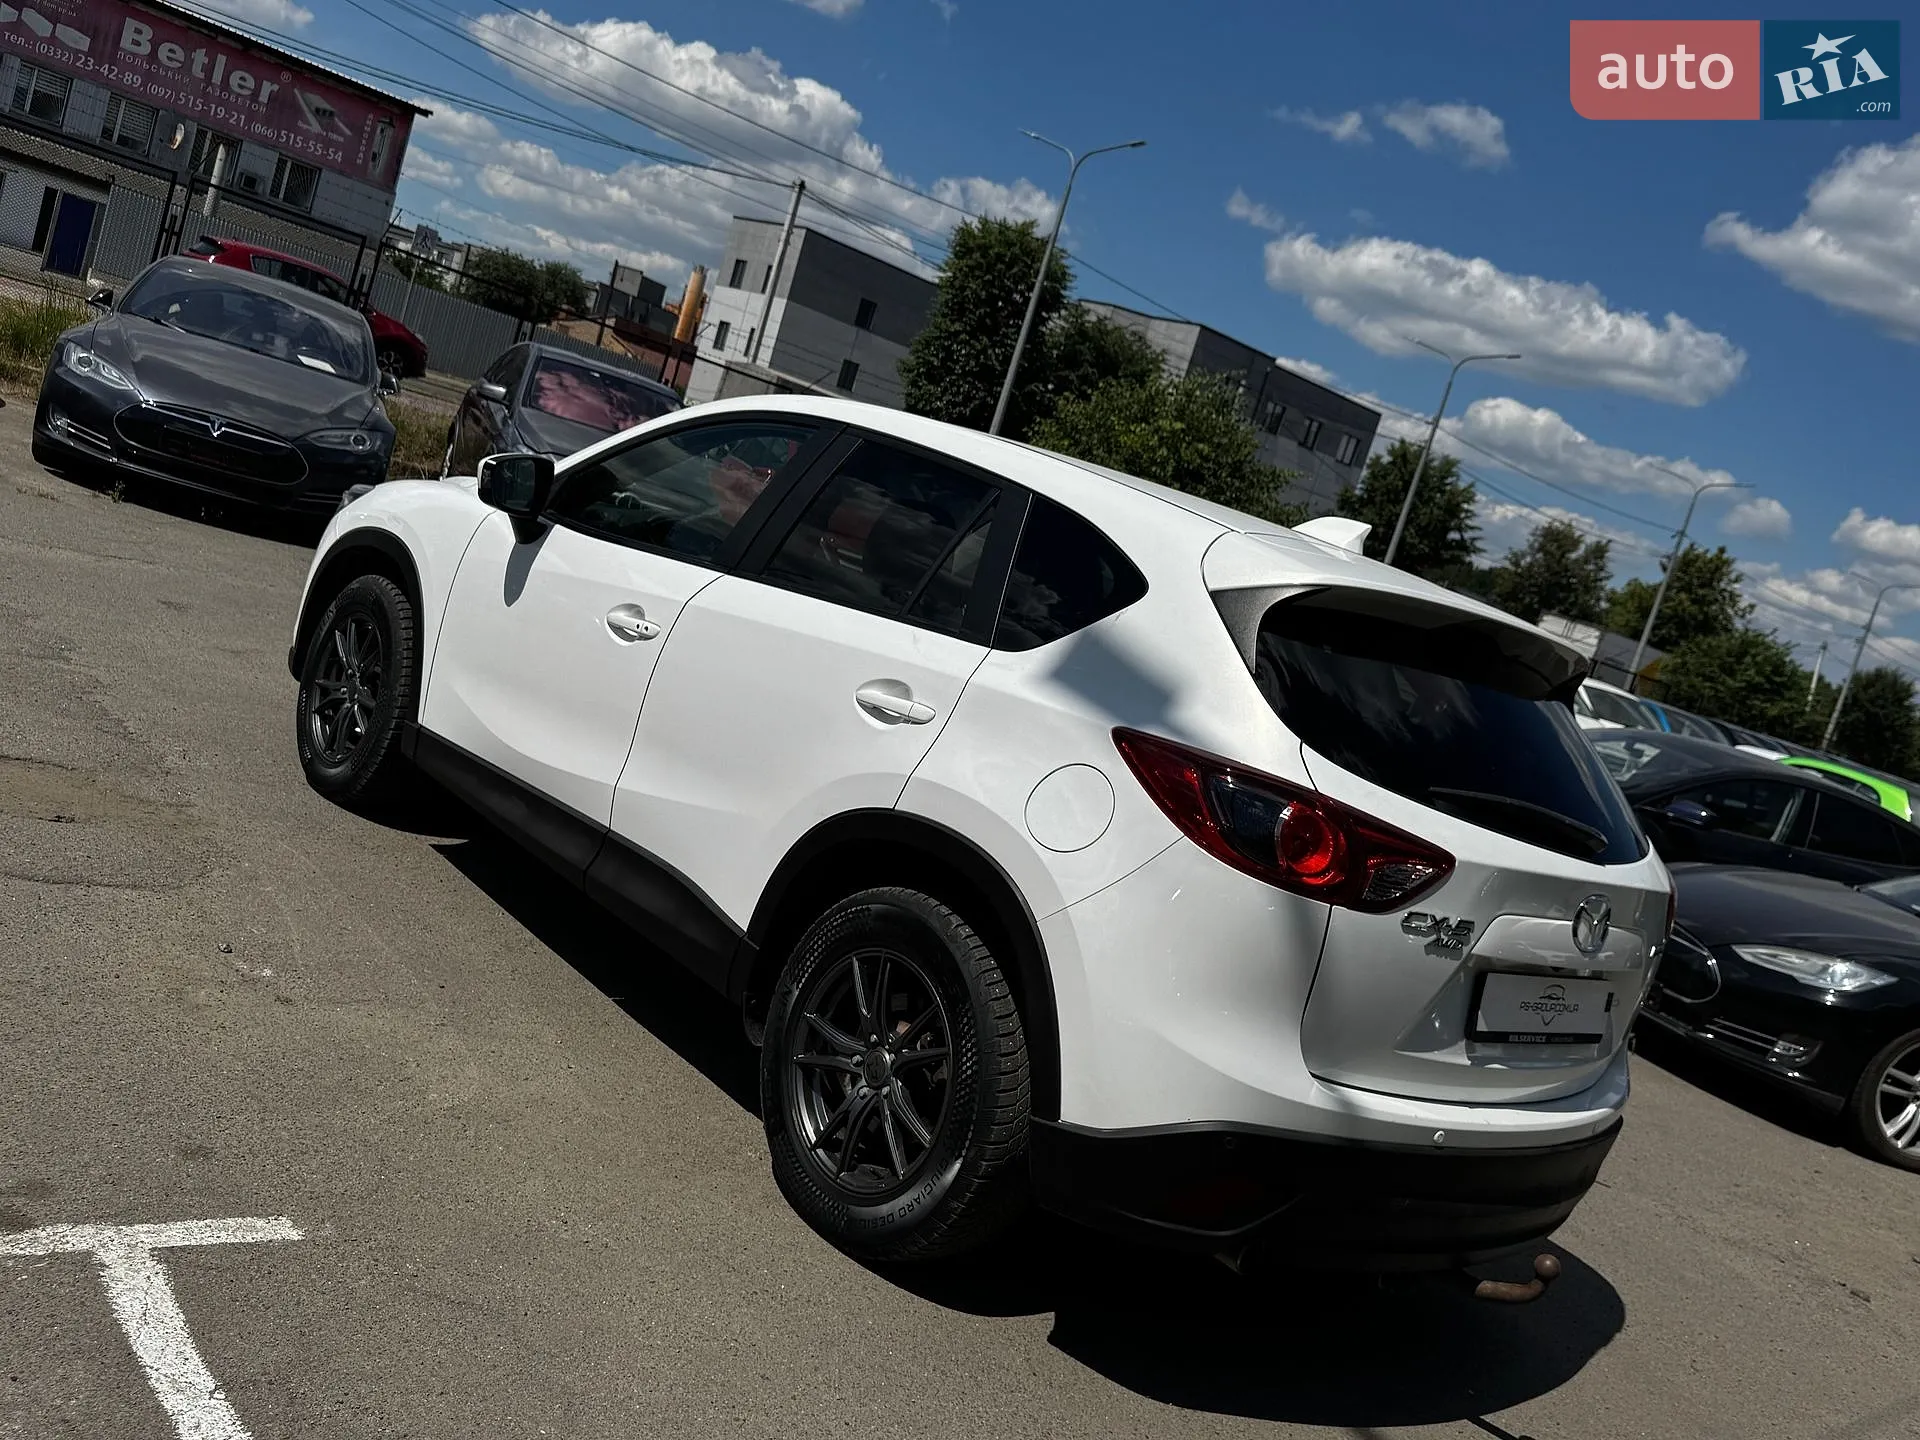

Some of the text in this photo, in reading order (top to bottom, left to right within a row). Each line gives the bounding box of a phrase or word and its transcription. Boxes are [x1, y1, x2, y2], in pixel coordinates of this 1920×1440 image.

[3, 31, 33, 49] тел.:
[35, 41, 74, 65] (0332)
[147, 82, 176, 104] (097)
[250, 120, 278, 141] (066)
[279, 131, 343, 164] 515-55-54
[119, 16, 280, 105] Betler
